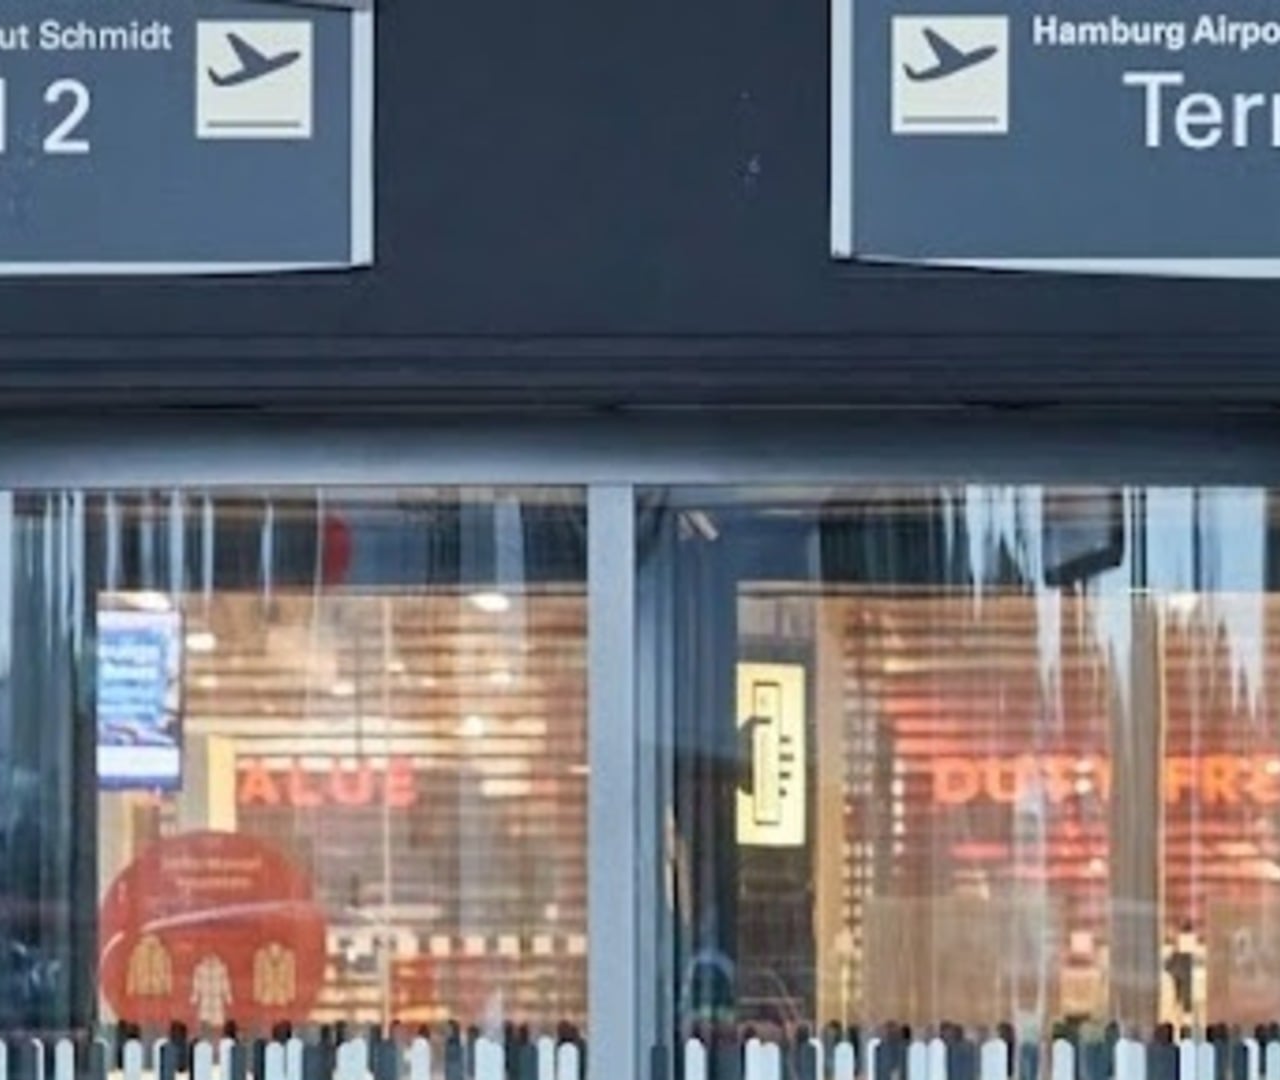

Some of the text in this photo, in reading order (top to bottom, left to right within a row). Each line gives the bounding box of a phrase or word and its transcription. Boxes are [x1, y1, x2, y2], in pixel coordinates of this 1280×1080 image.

[38, 18, 173, 51] Schmidt
[1032, 14, 1187, 52] Hamburg
[42, 77, 91, 154] 2
[238, 755, 418, 808] ALUE
